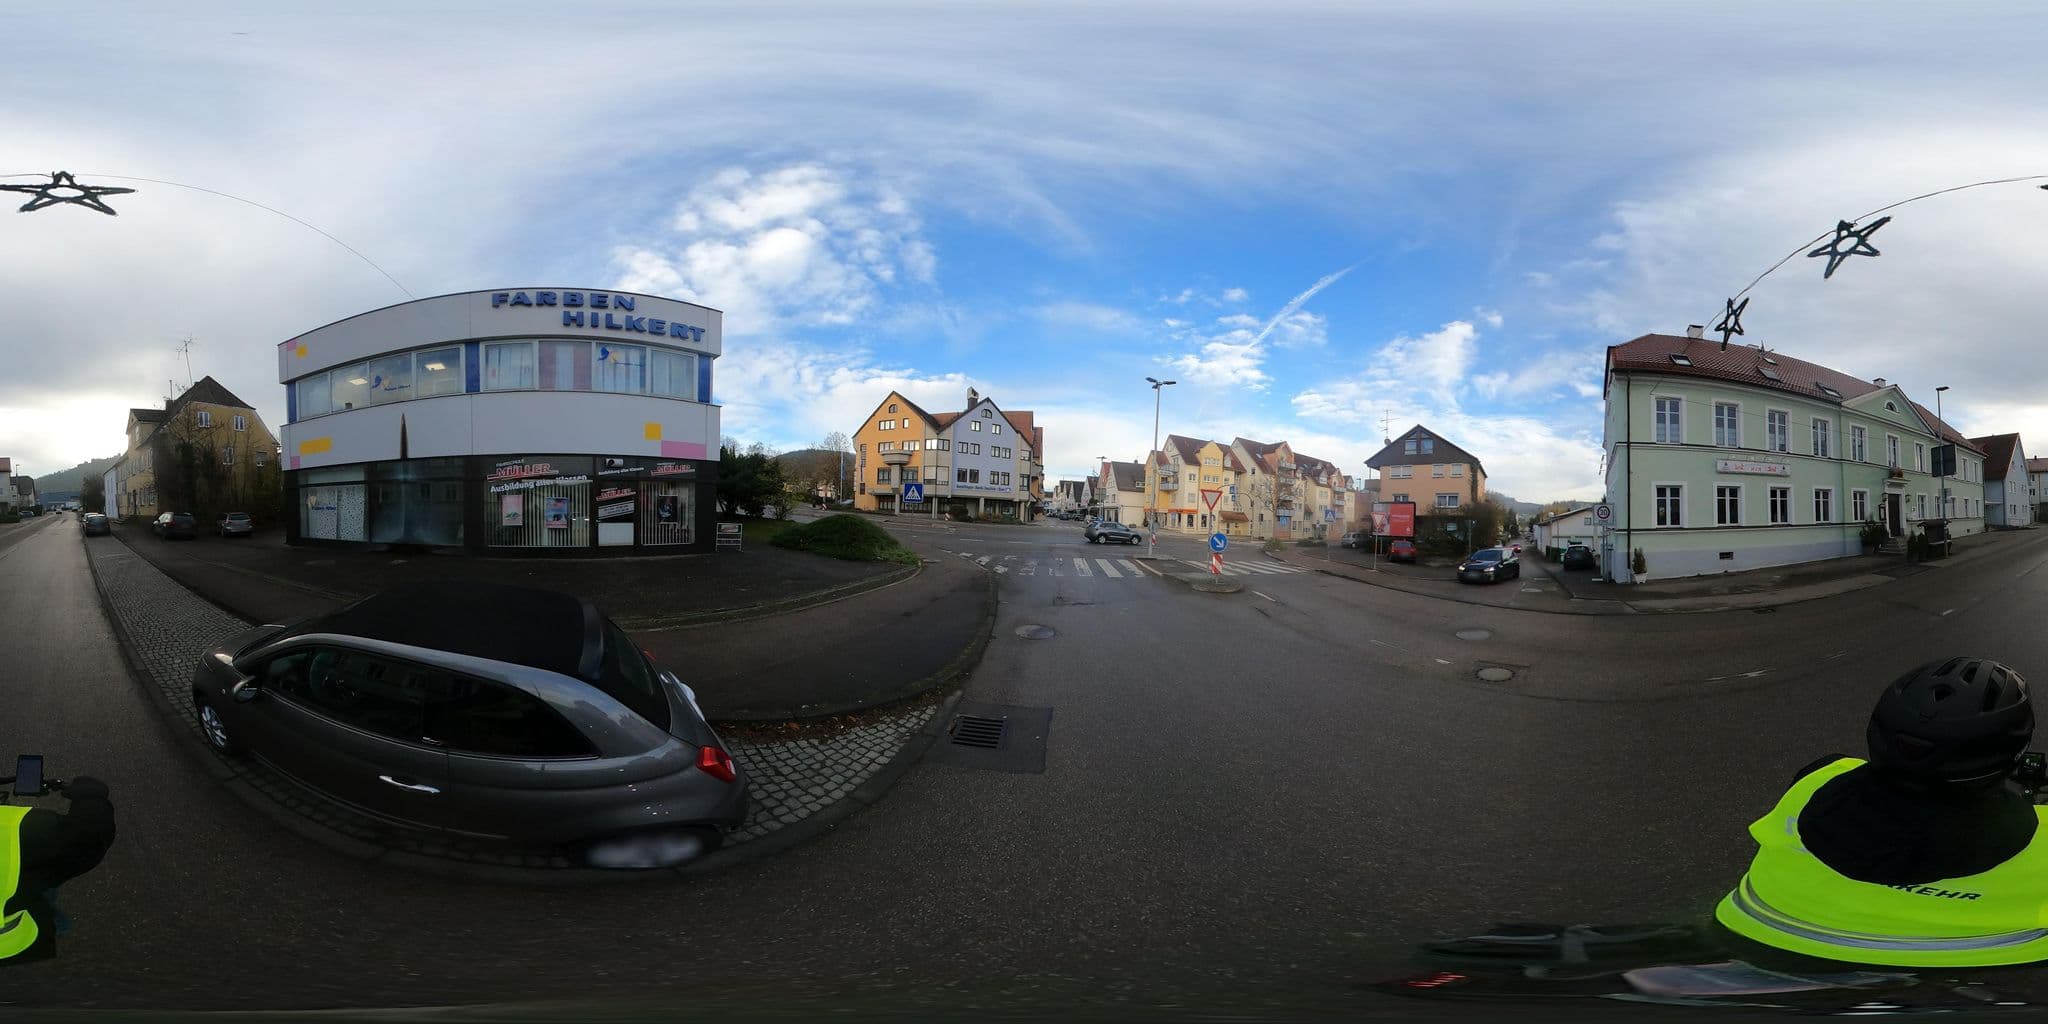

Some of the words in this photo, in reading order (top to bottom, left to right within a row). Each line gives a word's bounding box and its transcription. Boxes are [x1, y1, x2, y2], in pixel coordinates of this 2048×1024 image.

[491, 291, 635, 311] FARBEN
[562, 310, 706, 342] HILKERT
[495, 463, 551, 477] MÜLLER
[490, 481, 534, 493] Ausbildung
